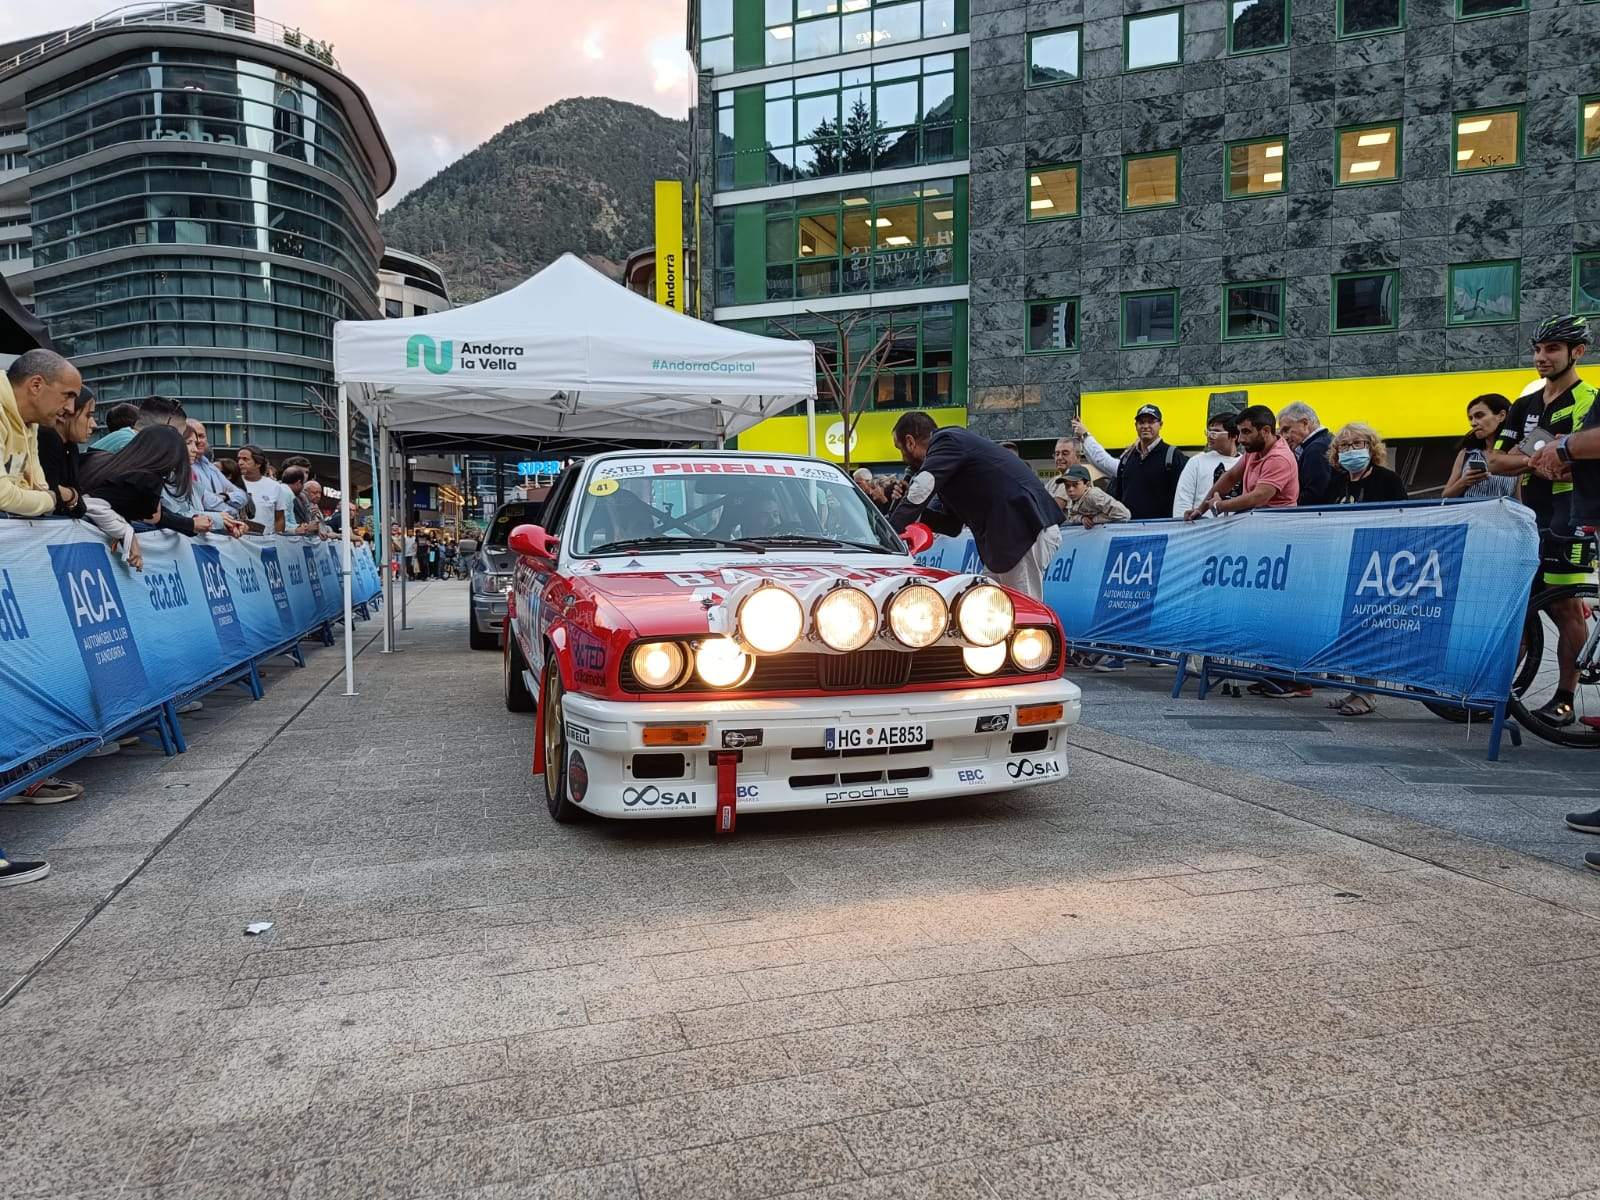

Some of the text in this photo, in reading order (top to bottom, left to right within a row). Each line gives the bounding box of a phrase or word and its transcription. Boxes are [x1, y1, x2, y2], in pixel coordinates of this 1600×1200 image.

[461, 343, 524, 355] Andorra
[461, 358, 517, 370] la Vella
[652, 360, 755, 373] #AndorraCapital
[518, 460, 560, 475] SUPER
[617, 464, 646, 473] TED
[652, 463, 796, 476] PIRELLI
[1106, 551, 1153, 585] ACA
[1202, 544, 1292, 591] aca.ad
[1355, 549, 1443, 597] ACA
[144, 560, 189, 611] aca.ad
[202, 562, 229, 599] ACA
[67, 568, 122, 628] ACA
[1134, 591, 1151, 600] CLUB
[1411, 605, 1442, 618] CLUB
[114, 627, 129, 640] CLUB
[839, 729, 861, 747] HG
[878, 726, 924, 745] AE853
[958, 769, 984, 781] EBC
[1034, 761, 1060, 775] SAI
[660, 791, 697, 805] SAI
[736, 785, 759, 798] BC
[826, 786, 909, 804] prodrive
